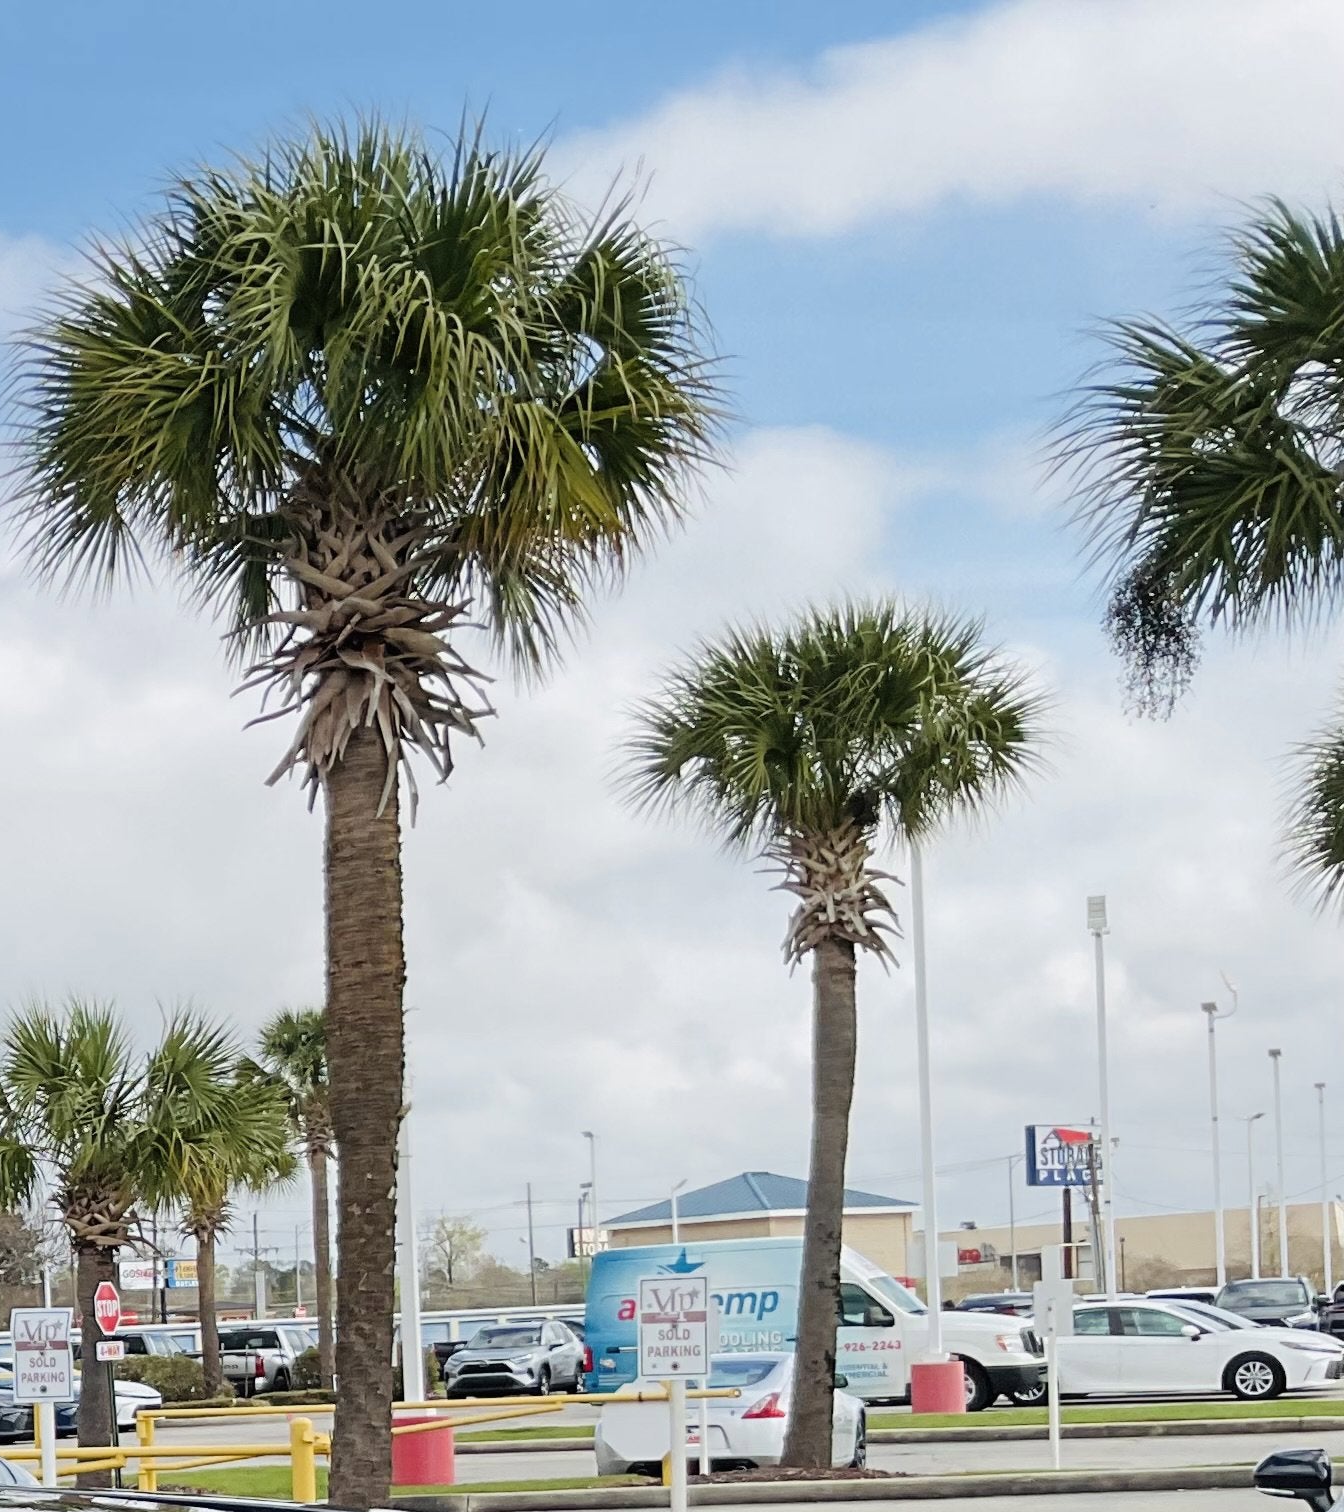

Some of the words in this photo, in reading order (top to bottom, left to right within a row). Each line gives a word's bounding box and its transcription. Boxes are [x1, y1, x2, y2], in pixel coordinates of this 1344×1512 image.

[97, 1300, 118, 1317] STOP
[657, 1328, 691, 1341] SOLD
[719, 1330, 783, 1347] OOLING
[100, 1344, 120, 1357] 4-WAY
[647, 1344, 701, 1358] PARKING
[29, 1357, 57, 1368] SOLD
[21, 1371, 65, 1383] PARKING
